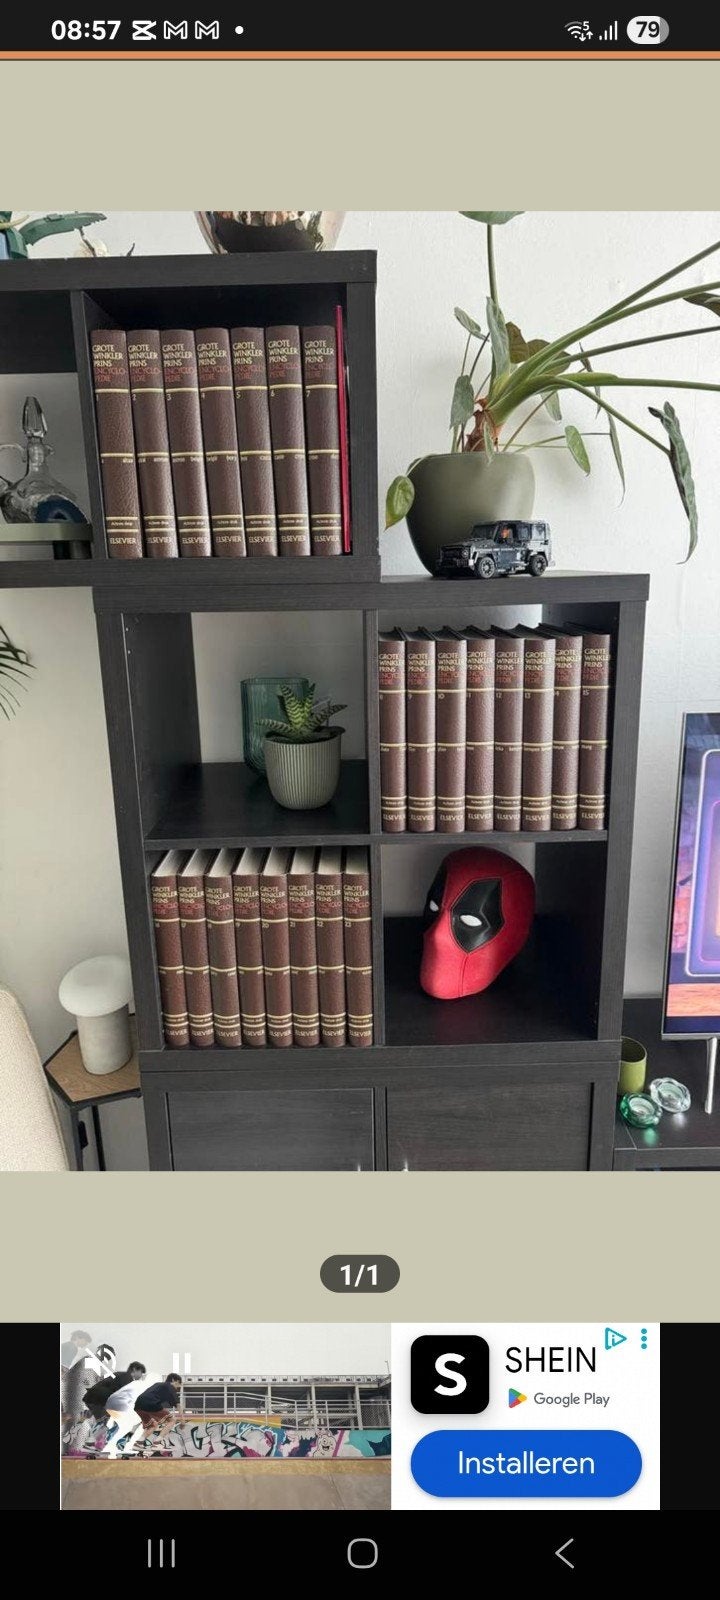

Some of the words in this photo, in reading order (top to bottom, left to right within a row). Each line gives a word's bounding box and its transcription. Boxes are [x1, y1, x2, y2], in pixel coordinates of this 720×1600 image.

[92, 344, 115, 352] GROTE
[128, 344, 150, 352] GROTE
[162, 344, 184, 352] GROTE
[232, 342, 255, 350] GROTE
[268, 340, 290, 348] GROTE
[304, 340, 327, 348] GROTE
[93, 352, 123, 360] WINKLER
[130, 352, 158, 360] WINKLER
[163, 351, 193, 359] WINKLER
[198, 350, 227, 358] WINKLER
[305, 348, 334, 356] WINKLER
[198, 358, 216, 366] PRINS
